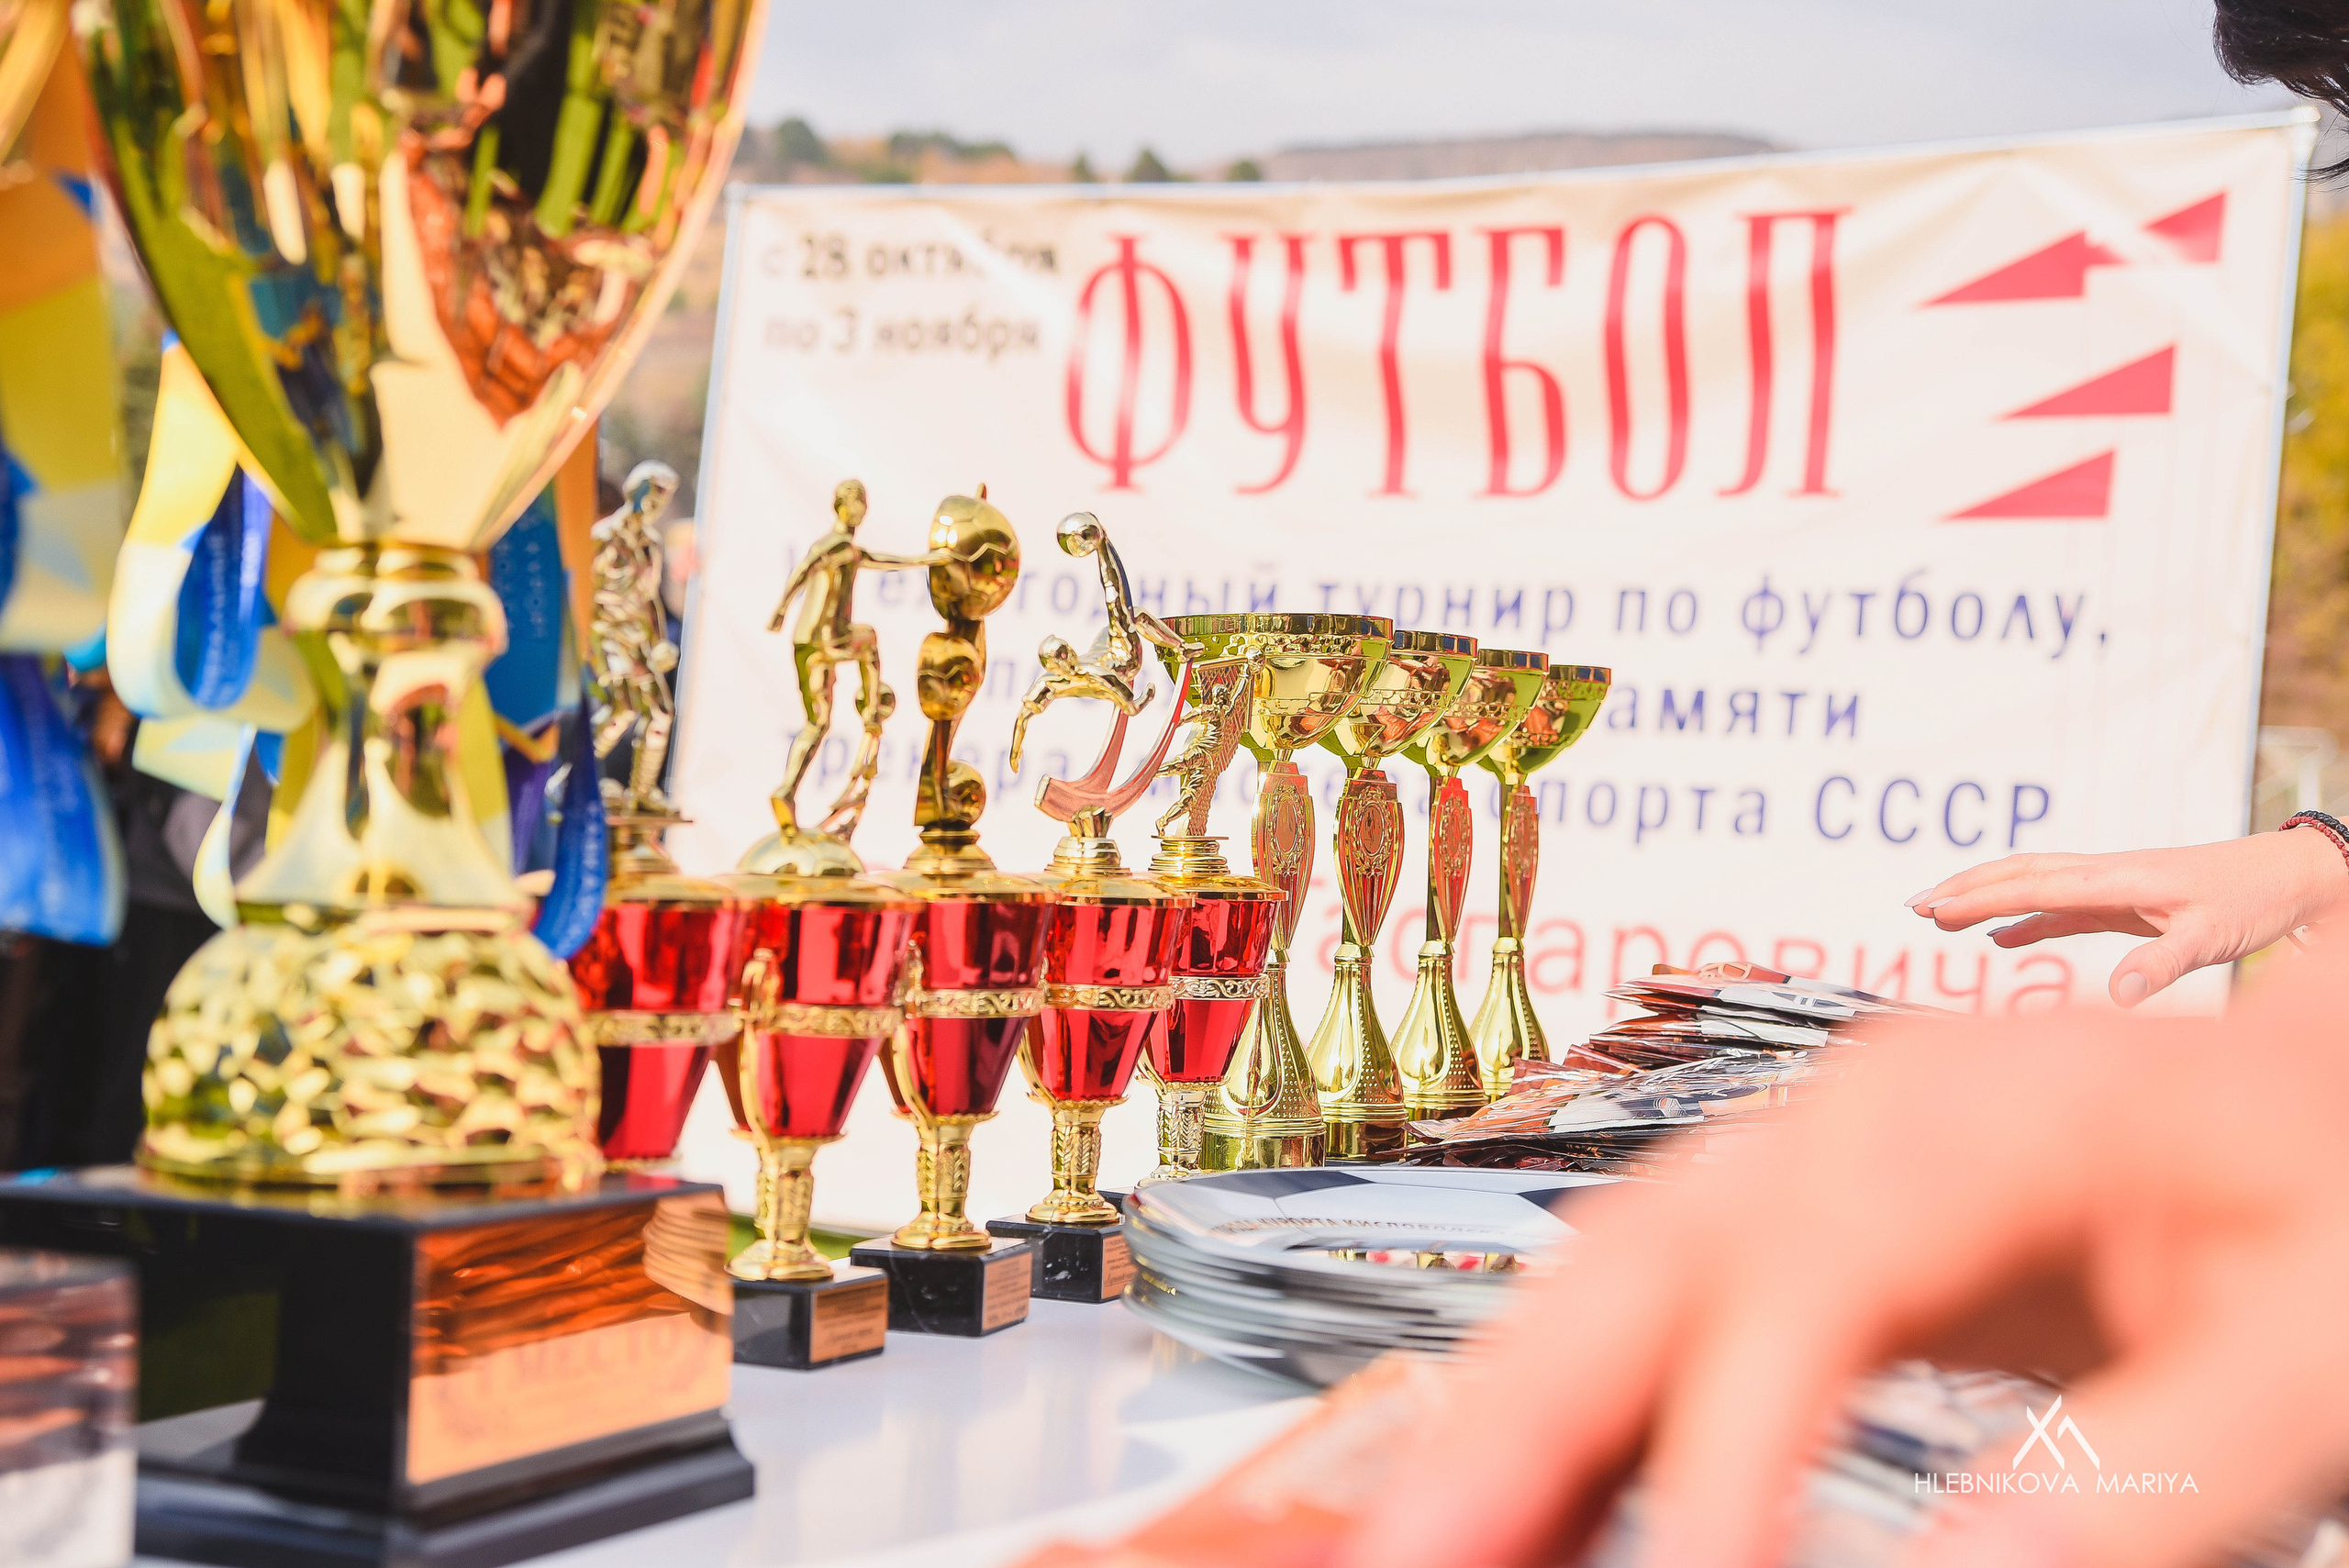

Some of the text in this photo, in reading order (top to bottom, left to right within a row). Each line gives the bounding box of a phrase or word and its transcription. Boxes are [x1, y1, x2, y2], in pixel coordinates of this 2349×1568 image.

[1064, 206, 1854, 501] ФУТБОЛ
[876, 558, 1279, 621] егоный
[1616, 589, 1698, 634] по
[1742, 567, 2107, 660] футболу,
[1608, 685, 1860, 740] амяти
[1493, 776, 1766, 845] порта
[1813, 774, 2051, 849] СССР
